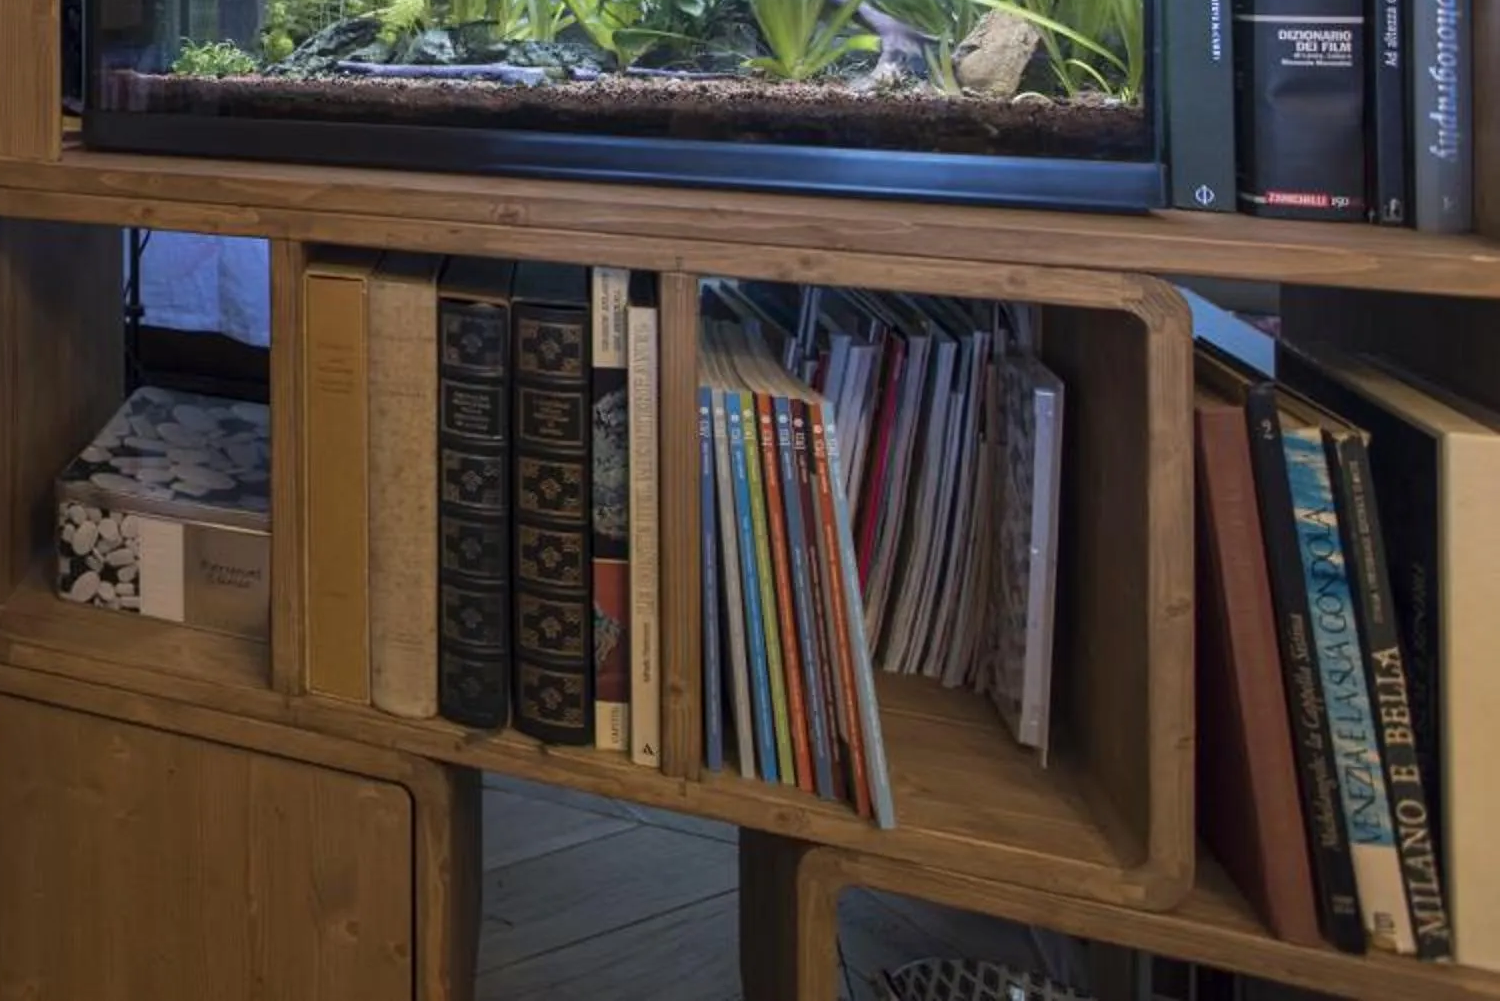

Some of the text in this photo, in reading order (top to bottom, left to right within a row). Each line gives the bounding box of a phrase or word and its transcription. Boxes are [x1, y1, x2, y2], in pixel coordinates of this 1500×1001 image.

[1278, 29, 1352, 41] DIZIONARIO
[1296, 42, 1352, 53] DEI FILM
[1384, 7, 1398, 48] altezza
[1384, 51, 1398, 67] Ad
[1261, 418, 1275, 440] 2
[1301, 505, 1348, 635] GONDOLA
[1324, 641, 1358, 686] SUA
[1333, 682, 1364, 727] LA
[1372, 646, 1415, 746] BELLA
[1346, 743, 1382, 844] VENEZIA
[1395, 800, 1450, 940] MILANO
